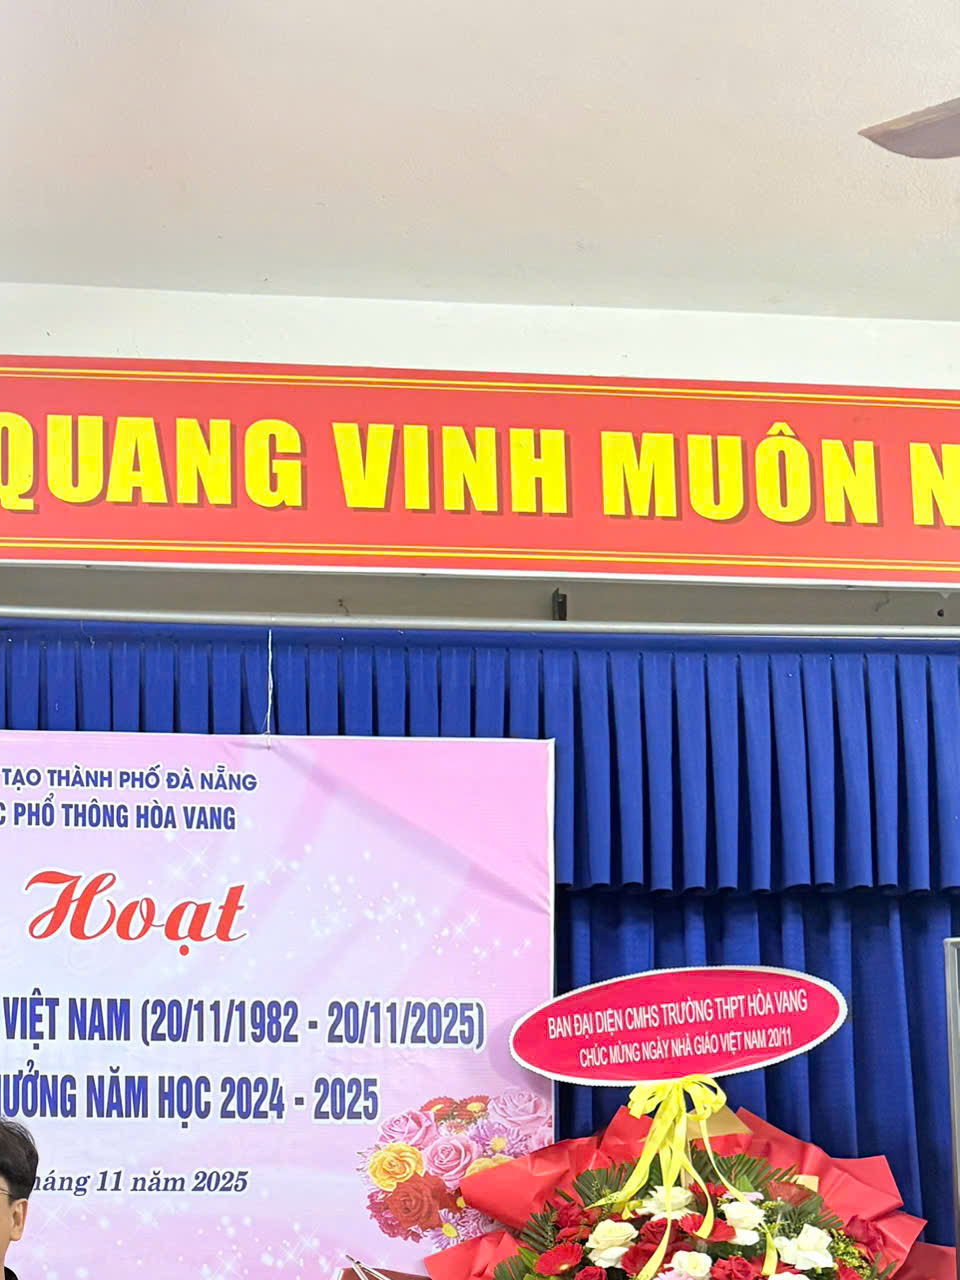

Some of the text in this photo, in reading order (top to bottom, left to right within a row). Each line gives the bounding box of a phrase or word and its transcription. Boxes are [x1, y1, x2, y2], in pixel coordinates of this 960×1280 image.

[332, 421, 568, 516] VINH
[601, 421, 879, 524] MUÔN
[2, 768, 42, 791] TẠO
[47, 764, 113, 788] THÀNH
[119, 764, 161, 789] PHỐ
[166, 767, 195, 790] ĐÀ
[200, 764, 258, 791] NẴNG
[13, 792, 55, 827] PHỔ
[61, 798, 129, 828] THÔNG
[136, 799, 177, 829] HÒA
[182, 806, 236, 830] VANG
[24, 870, 247, 956] Hoạt
[3, 987, 60, 1050] VIỆT
[68, 997, 131, 1041] NAM
[141, 998, 299, 1046] (20/11/1982
[308, 1019, 318, 1030] -
[327, 1000, 485, 1049] 20/11/2025)
[547, 987, 809, 1040] BAN ĐẠI DIỆN CMHS TRƯỜNG THPT HÒA VANG
[580, 1026, 793, 1068] CHÚC MỪNG NGÀY NHÀ GIÁO VIỆT NAM 20/11
[87, 1065, 149, 1119] NĂM
[158, 1076, 211, 1129] HỌC
[220, 1076, 285, 1120] 2024
[294, 1096, 305, 1106] -
[314, 1077, 378, 1121] 2025
[96, 1170, 123, 1192] 11
[131, 1168, 186, 1193] năm
[192, 1170, 249, 1193] 2025
